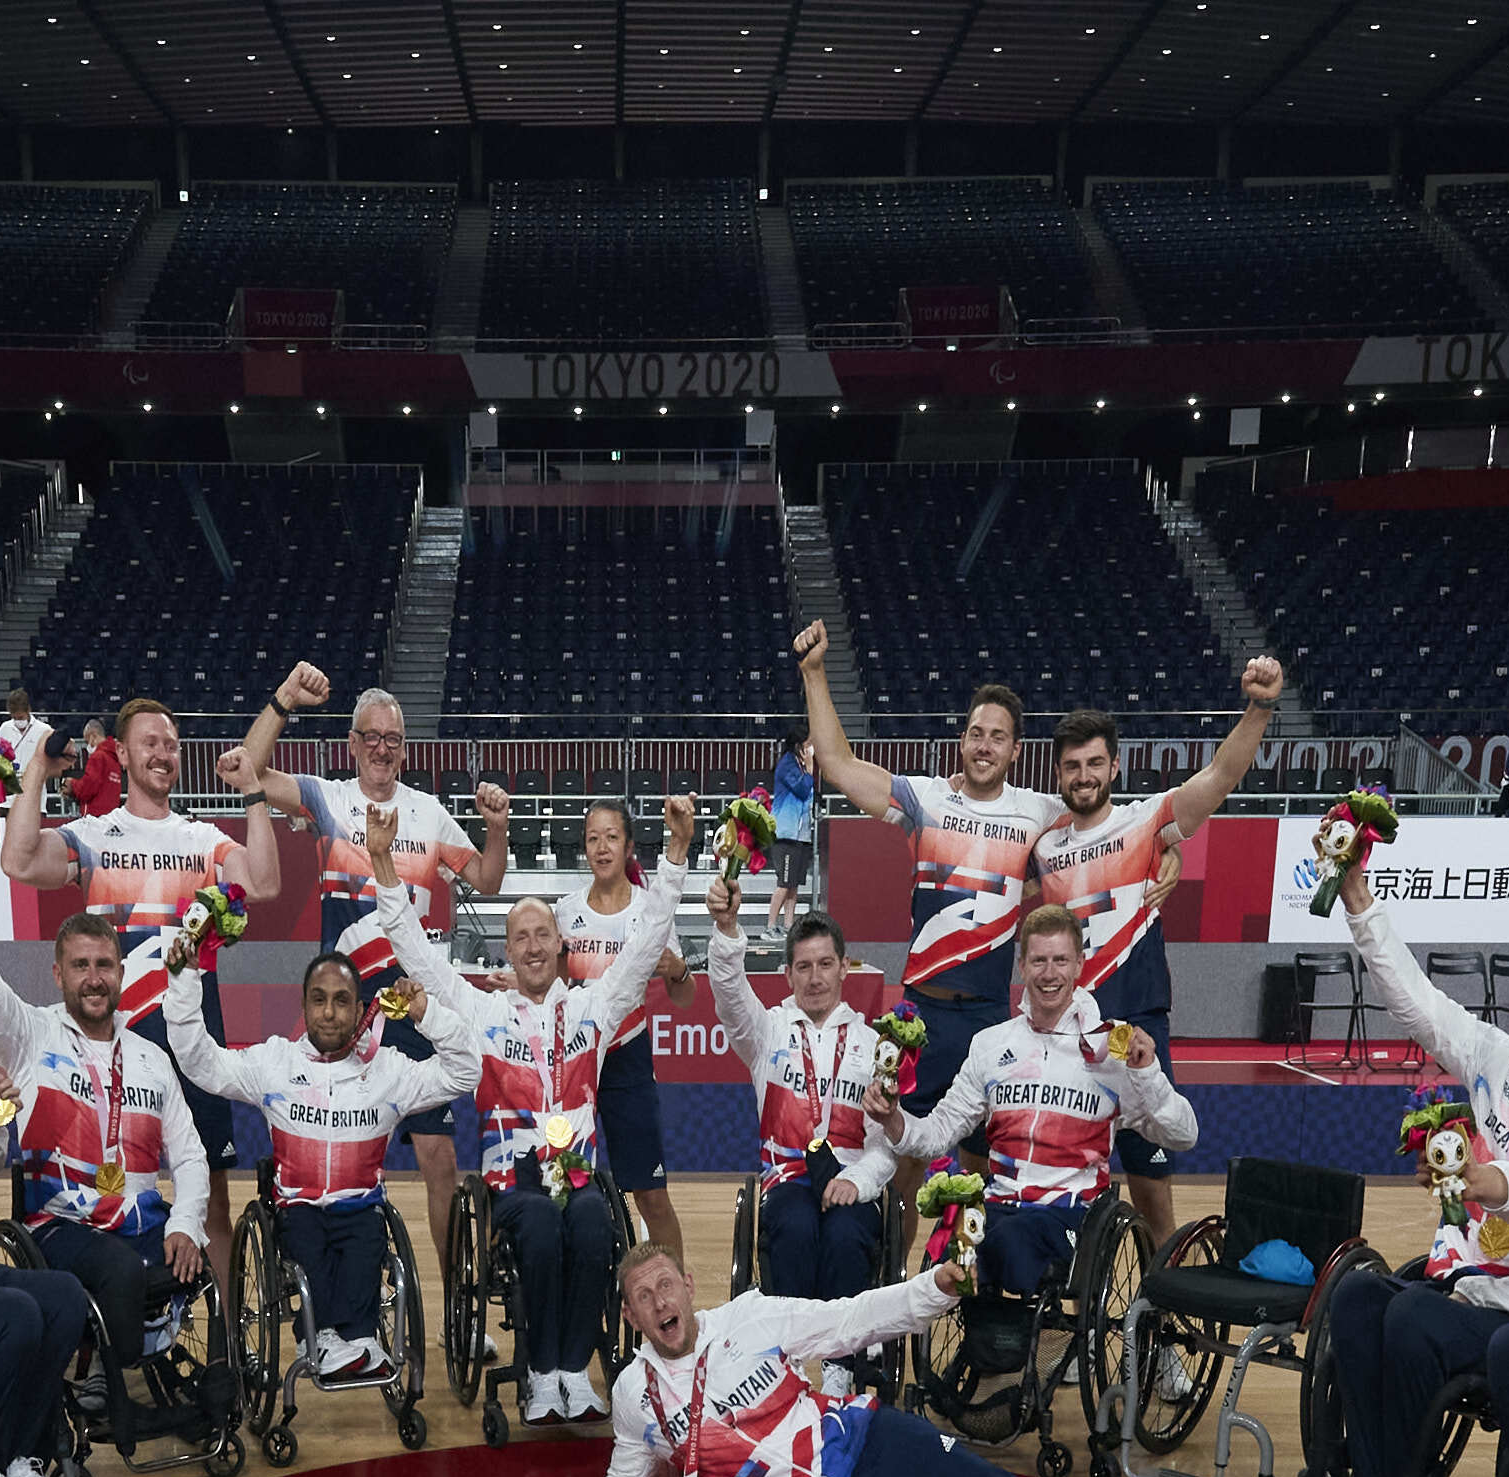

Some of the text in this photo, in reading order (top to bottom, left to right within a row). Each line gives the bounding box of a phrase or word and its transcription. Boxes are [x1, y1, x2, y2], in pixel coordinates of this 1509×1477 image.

[524, 350, 780, 399] TOKYO 2020
[943, 815, 1026, 845] GREAT BRITAIN
[101, 851, 205, 874] GREAT BRITAIN
[1047, 838, 1123, 874] GREAT BRITAIN
[996, 1084, 1100, 1115] GREAT BRITAIN
[289, 1102, 378, 1128] GREAT BRITAIN
